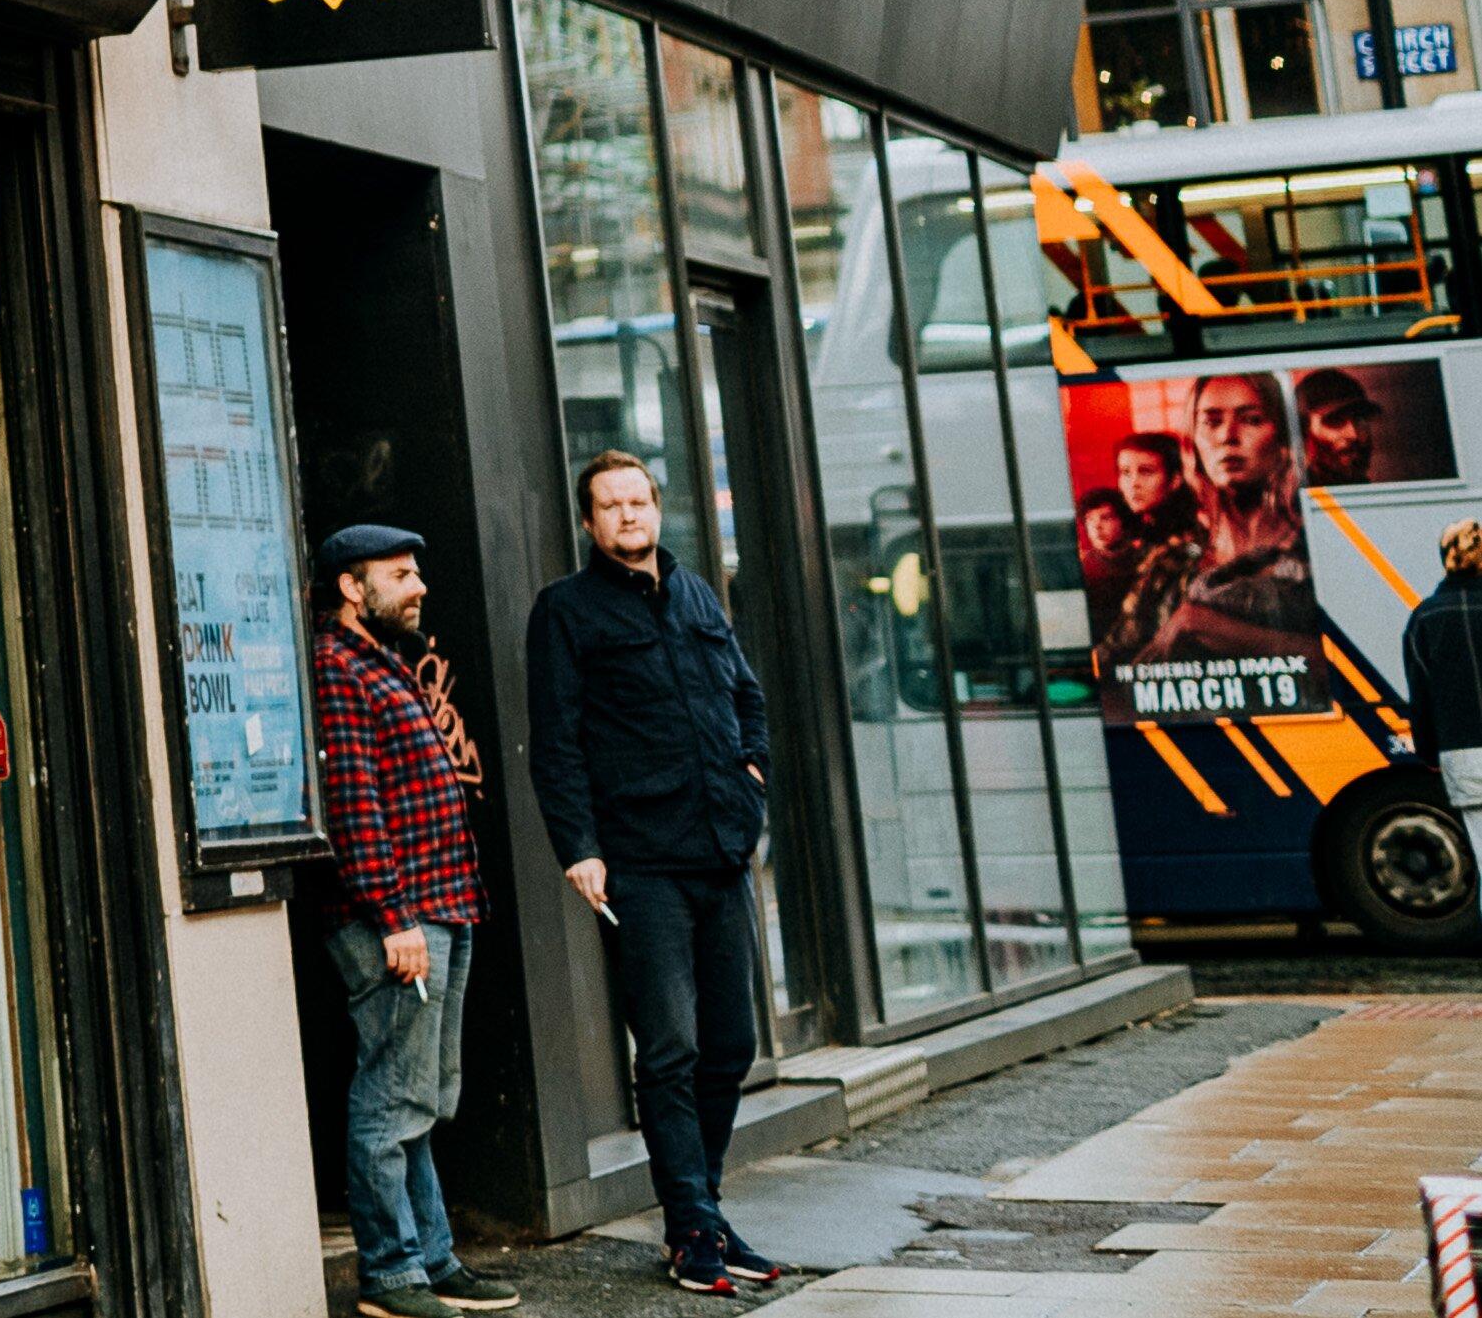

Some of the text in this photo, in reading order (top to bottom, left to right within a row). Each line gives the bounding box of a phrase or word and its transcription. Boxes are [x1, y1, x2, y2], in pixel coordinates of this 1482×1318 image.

[182, 621, 237, 663] DRINK
[1136, 660, 1203, 681] CINEMAS
[1239, 655, 1309, 676] IMAX
[188, 672, 237, 715] BOWL
[1132, 674, 1301, 713] MARCH 19
